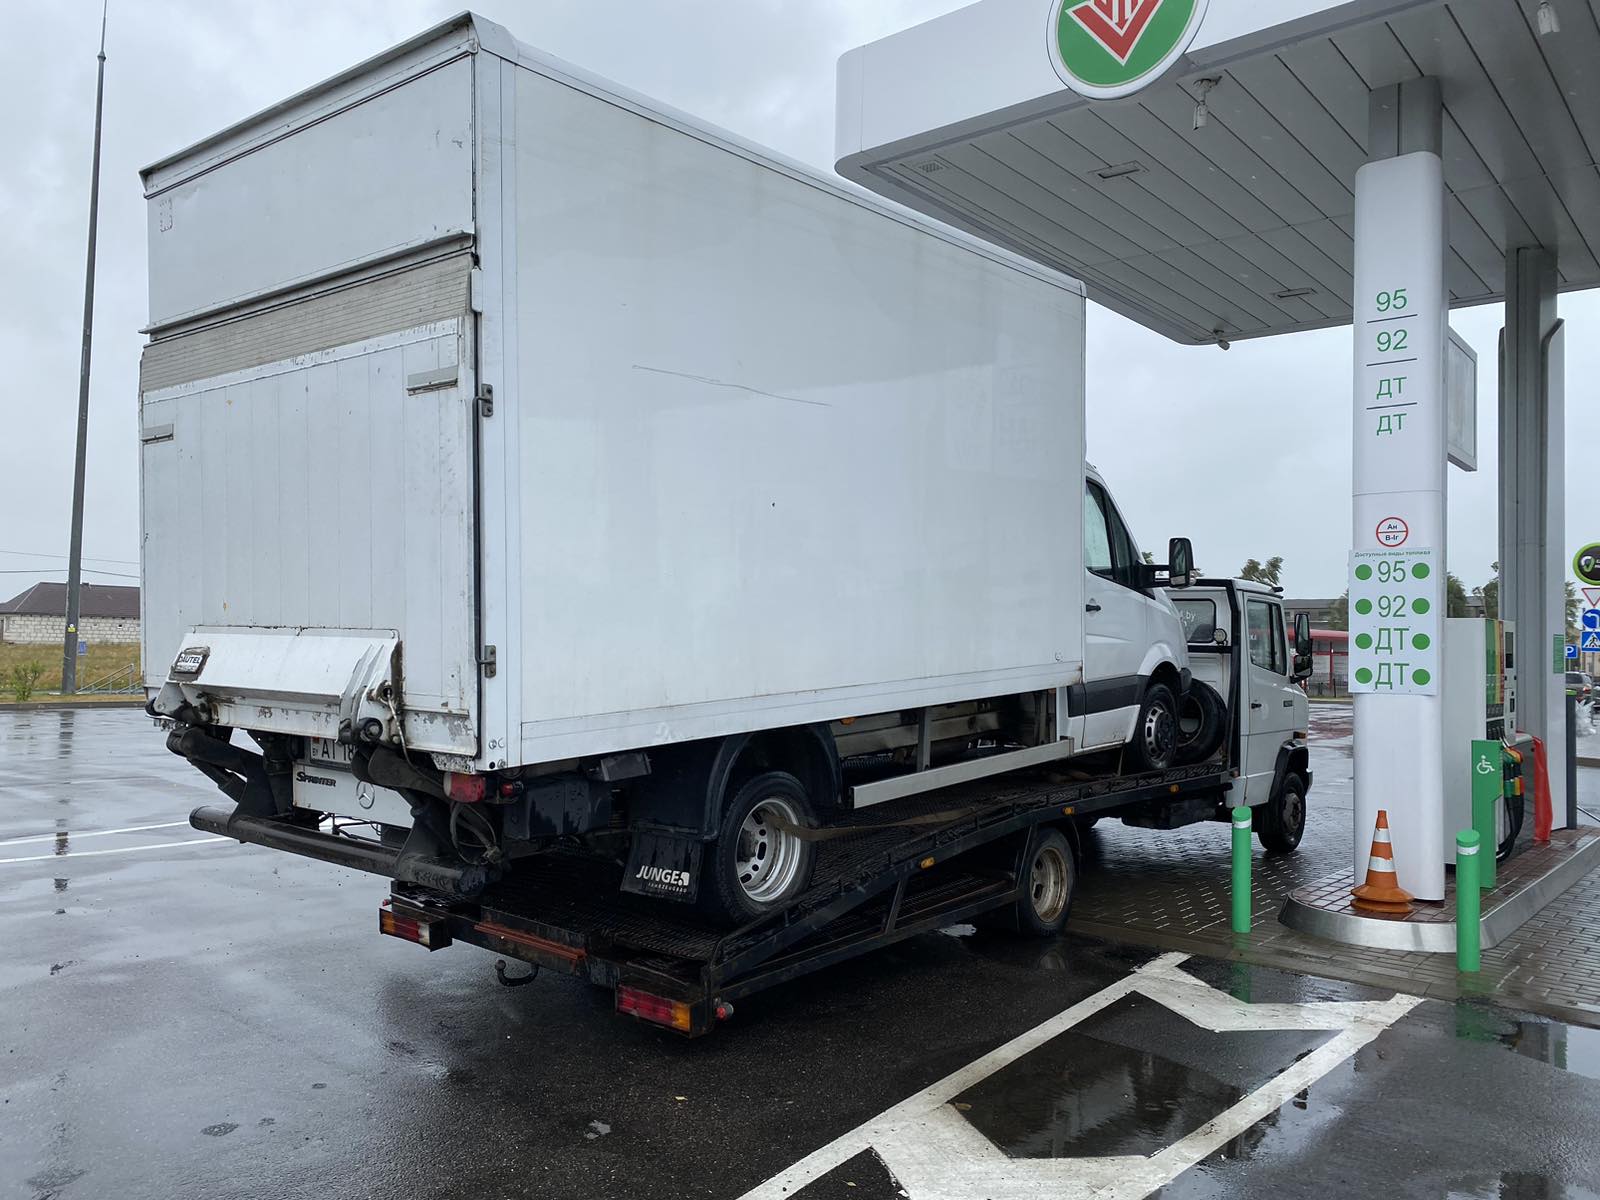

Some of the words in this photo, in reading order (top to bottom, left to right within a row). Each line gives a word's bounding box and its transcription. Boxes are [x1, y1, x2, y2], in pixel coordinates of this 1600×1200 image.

[1376, 288, 1408, 312] 95
[1376, 328, 1408, 352] 92
[1376, 376, 1408, 400] ДТ
[1376, 412, 1408, 436] ДТ
[1377, 560, 1407, 583] 95
[1377, 595, 1407, 618] 92
[1374, 627, 1410, 655] ДТ
[1374, 662, 1410, 690] ДТ
[635, 865, 681, 884] JUNGE
